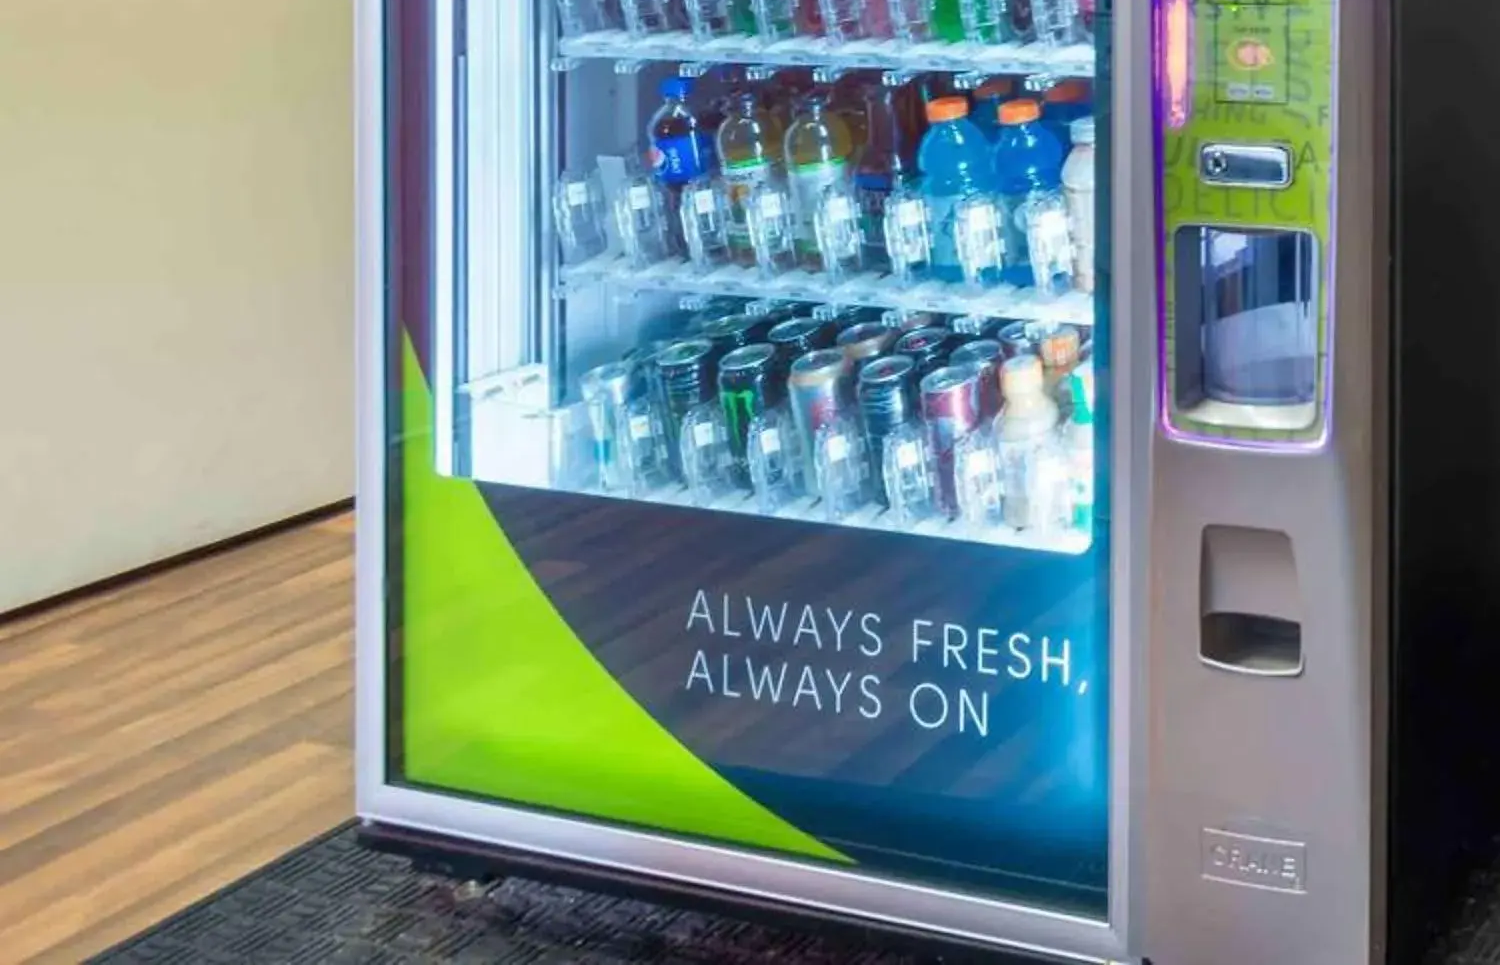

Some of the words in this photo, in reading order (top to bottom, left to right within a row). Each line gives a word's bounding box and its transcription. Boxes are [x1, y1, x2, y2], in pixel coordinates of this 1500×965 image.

[686, 589, 882, 656] ALWAYS
[912, 619, 1089, 695] FRESH,
[685, 650, 882, 718] ALWAYS
[909, 683, 988, 737] ON
